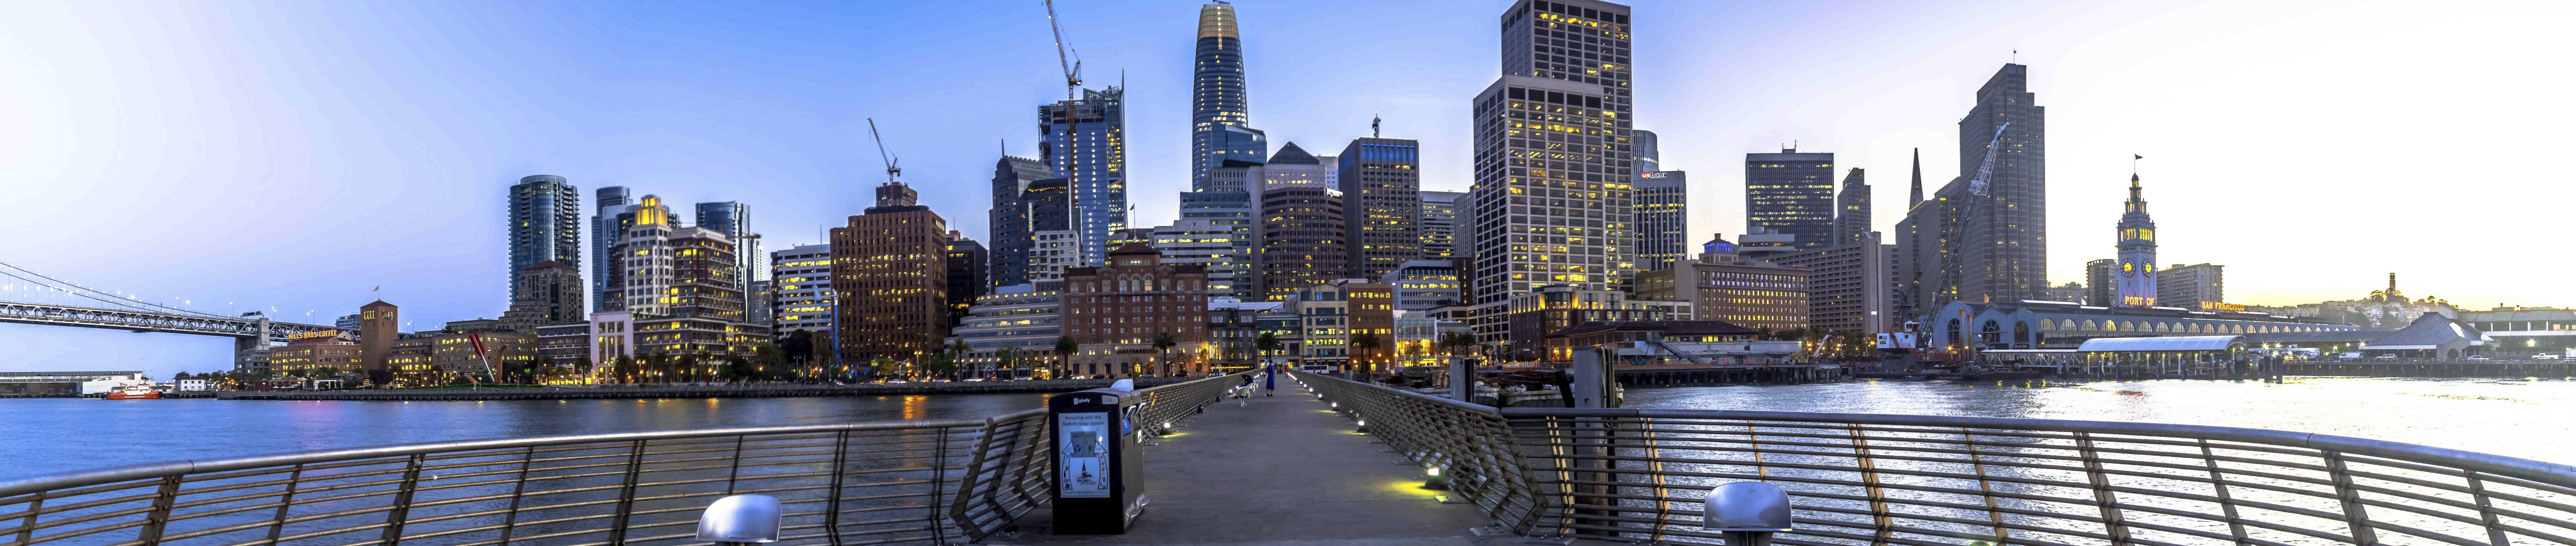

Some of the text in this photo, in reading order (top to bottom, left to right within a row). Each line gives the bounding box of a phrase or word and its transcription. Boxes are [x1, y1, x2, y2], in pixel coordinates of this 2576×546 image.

[2125, 296, 2155, 306] PORT OF
[2202, 301, 2244, 311] SAN FRANCISCO
